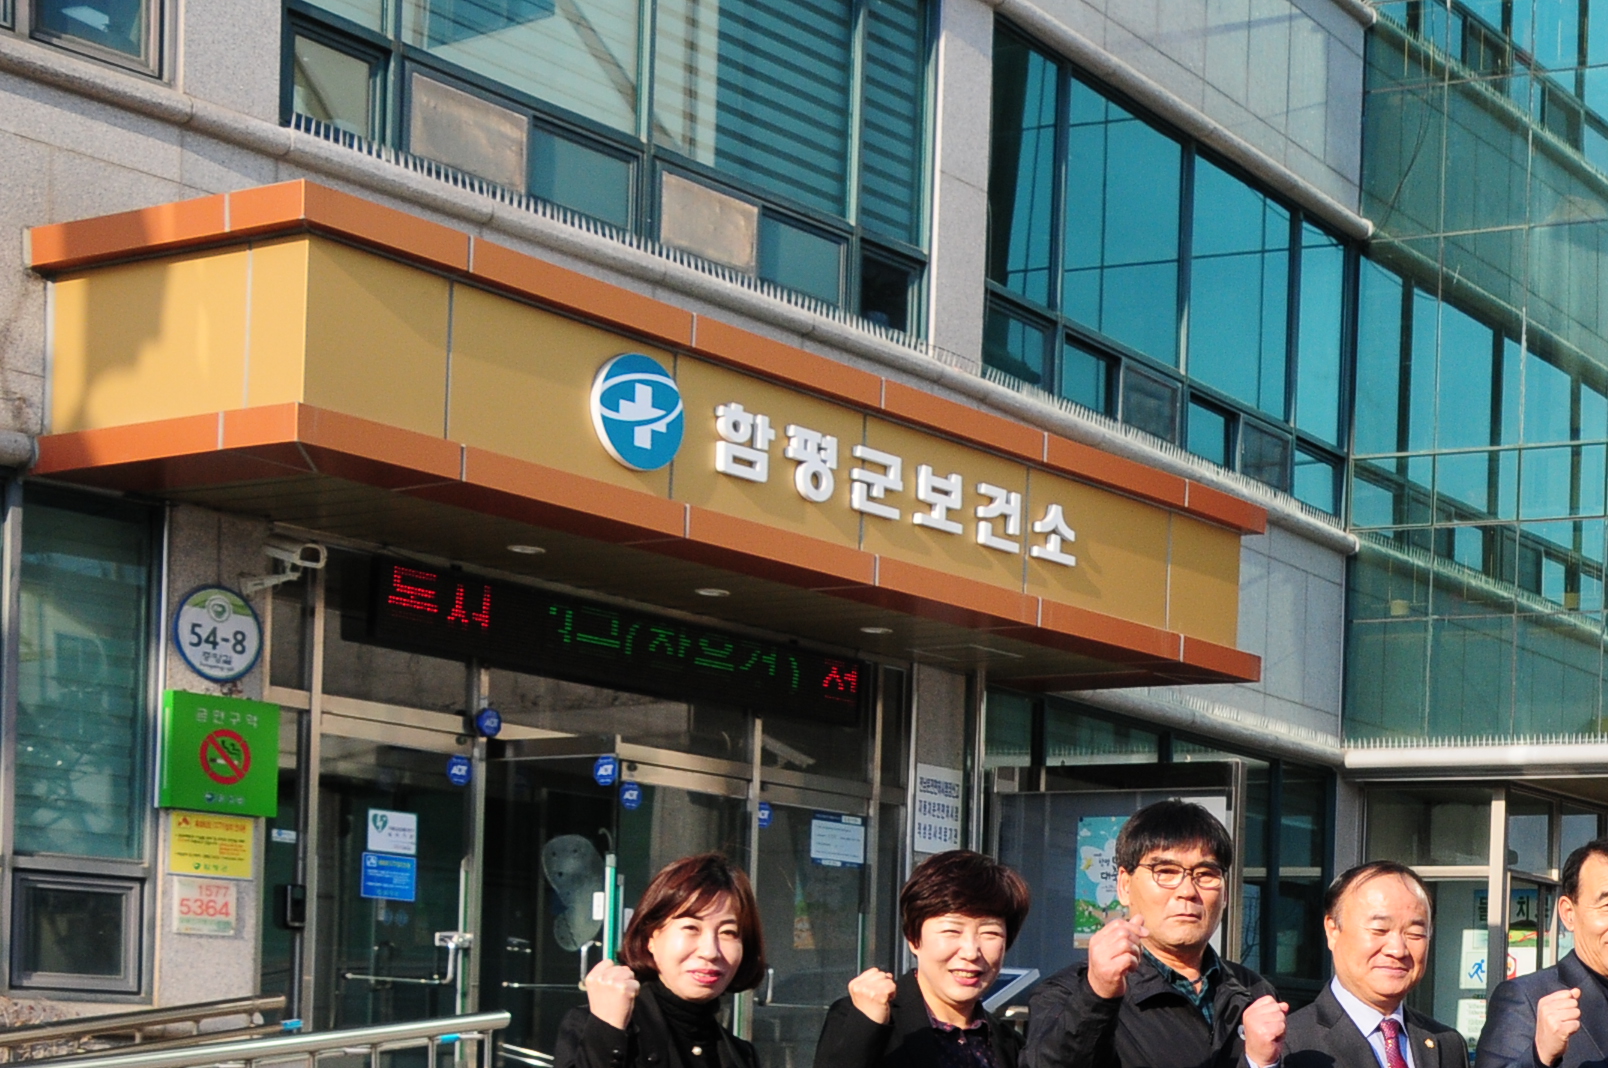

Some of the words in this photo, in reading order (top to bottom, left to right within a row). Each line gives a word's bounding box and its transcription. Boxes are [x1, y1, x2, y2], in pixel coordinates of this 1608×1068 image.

[715, 402, 1076, 567] 함평군보건소
[189, 622, 246, 655] 54-8
[196, 707, 258, 728] 금연구역
[451, 764, 468, 776] ADT
[597, 764, 614, 776] ADT
[623, 790, 638, 800] ADT
[198, 884, 230, 898] 1577
[179, 898, 231, 918] 5364
